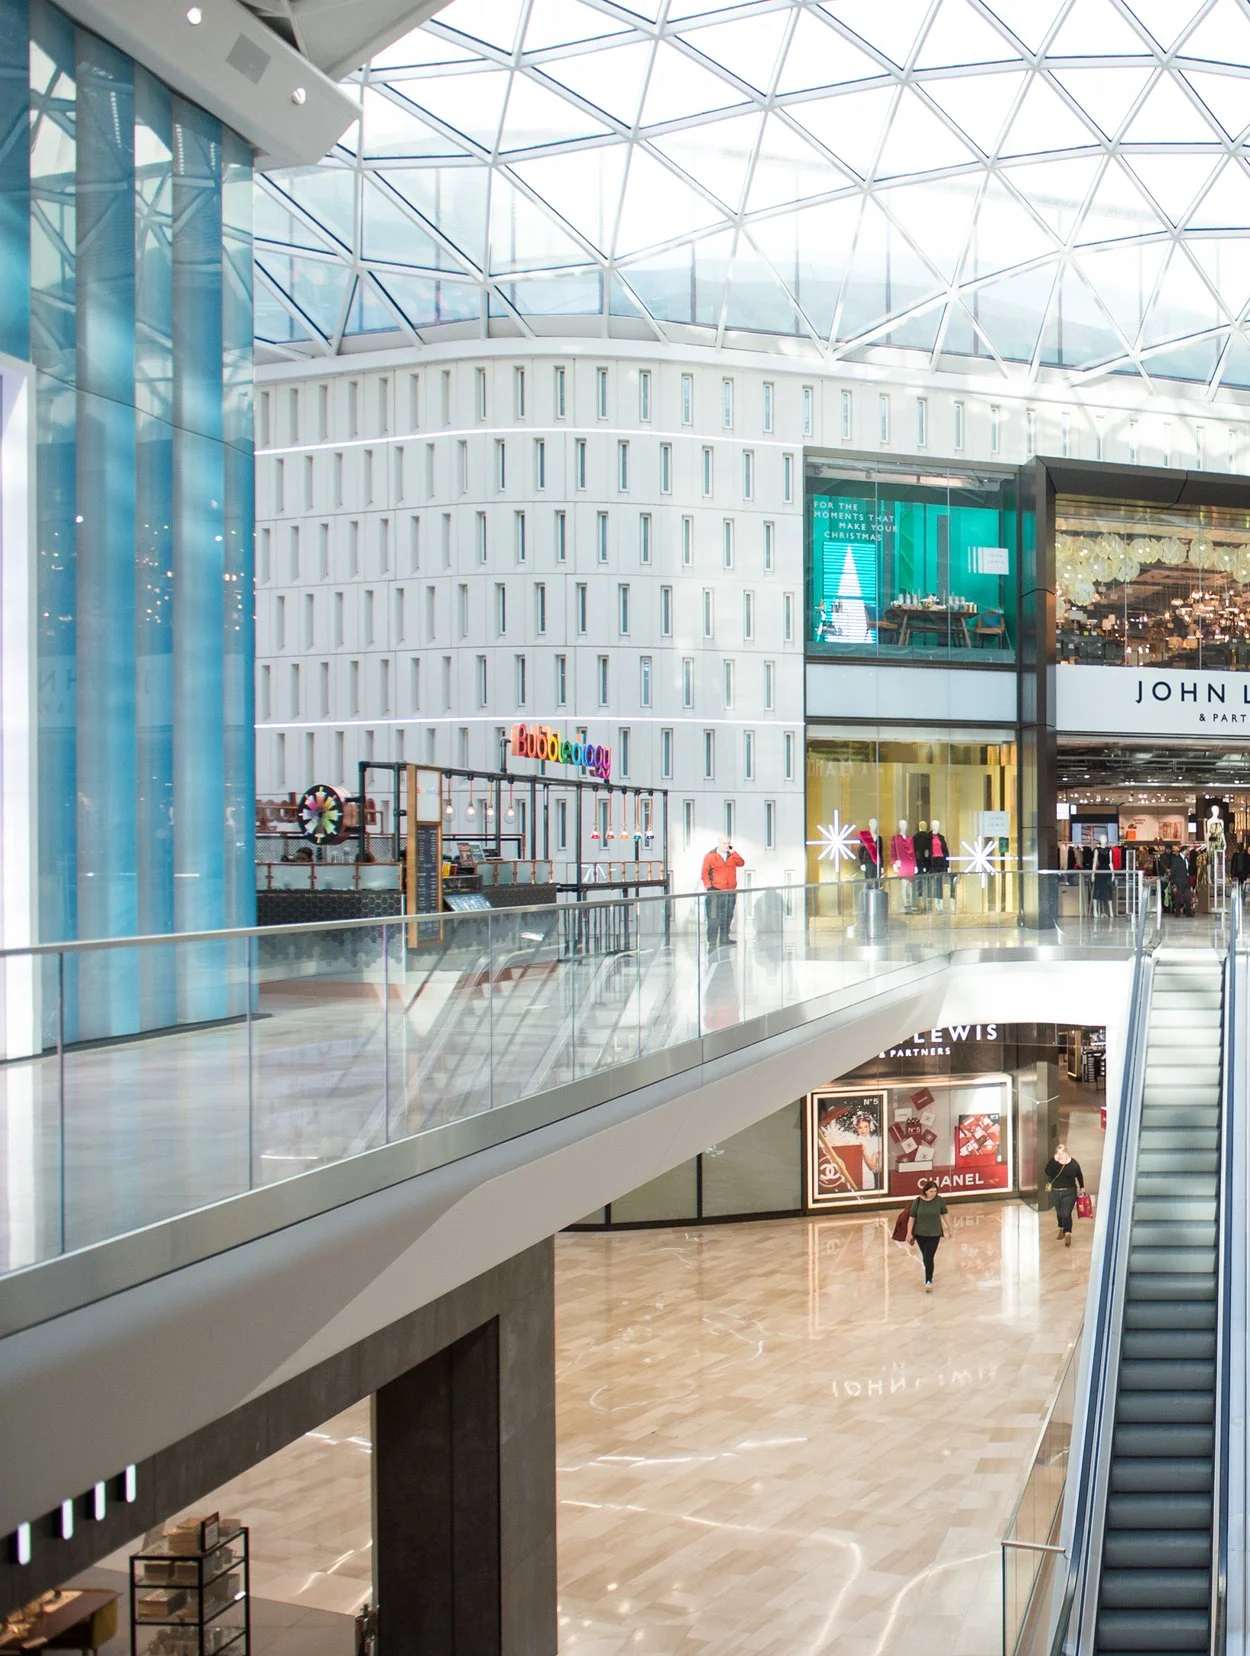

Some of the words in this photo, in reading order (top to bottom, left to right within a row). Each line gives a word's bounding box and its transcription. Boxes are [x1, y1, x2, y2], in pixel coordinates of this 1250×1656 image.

[813, 501, 834, 509] FOR
[838, 502, 858, 511] THE
[813, 511, 864, 521] MOMENTS
[868, 514, 894, 523] THAT
[839, 522, 867, 531] MAKE
[870, 524, 898, 533] YOUR
[824, 531, 882, 541] CHRISTMAS
[1135, 681, 1225, 704] JOHN
[1199, 713, 1206, 722] &
[511, 722, 611, 780] Bubbleology
[913, 1024, 997, 1043] LEWIS
[890, 1047, 951, 1058] PARTNERS
[917, 1173, 984, 1190] CHANEL
